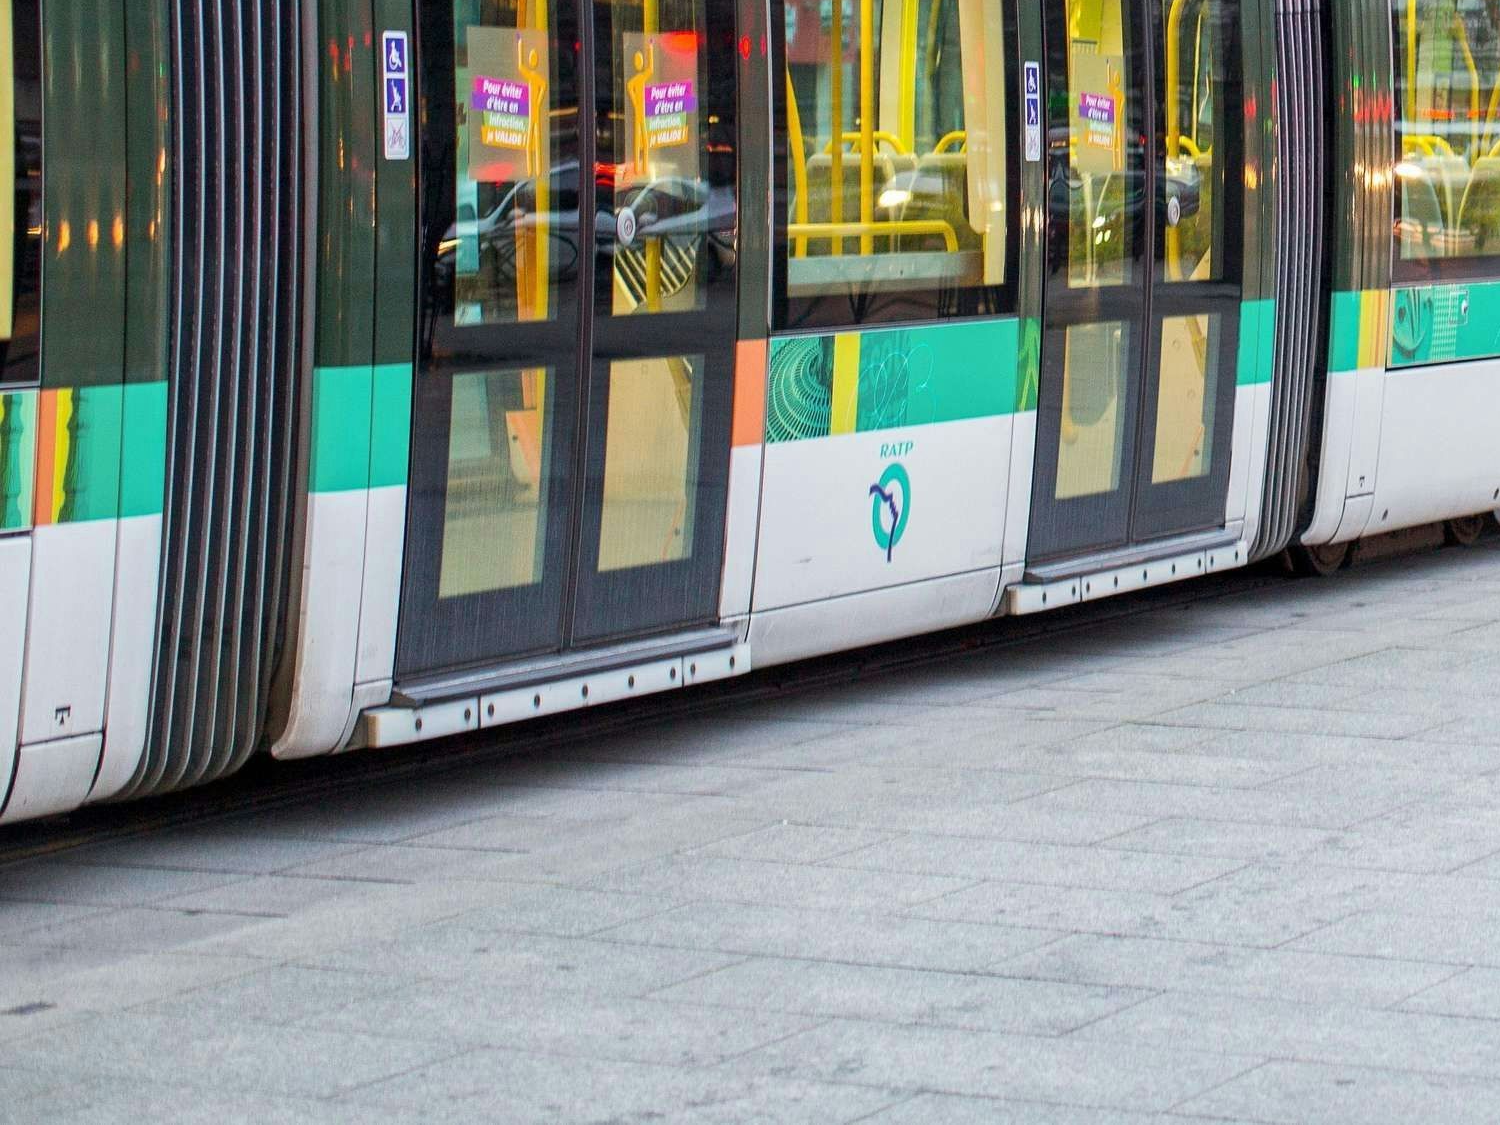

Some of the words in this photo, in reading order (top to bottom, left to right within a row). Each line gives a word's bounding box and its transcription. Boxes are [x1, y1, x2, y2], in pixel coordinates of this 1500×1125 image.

[482, 79, 501, 95] Pour
[502, 82, 522, 100] éviter
[651, 86, 667, 101] Pour
[509, 101, 519, 114] en
[880, 442, 913, 458] RATP
